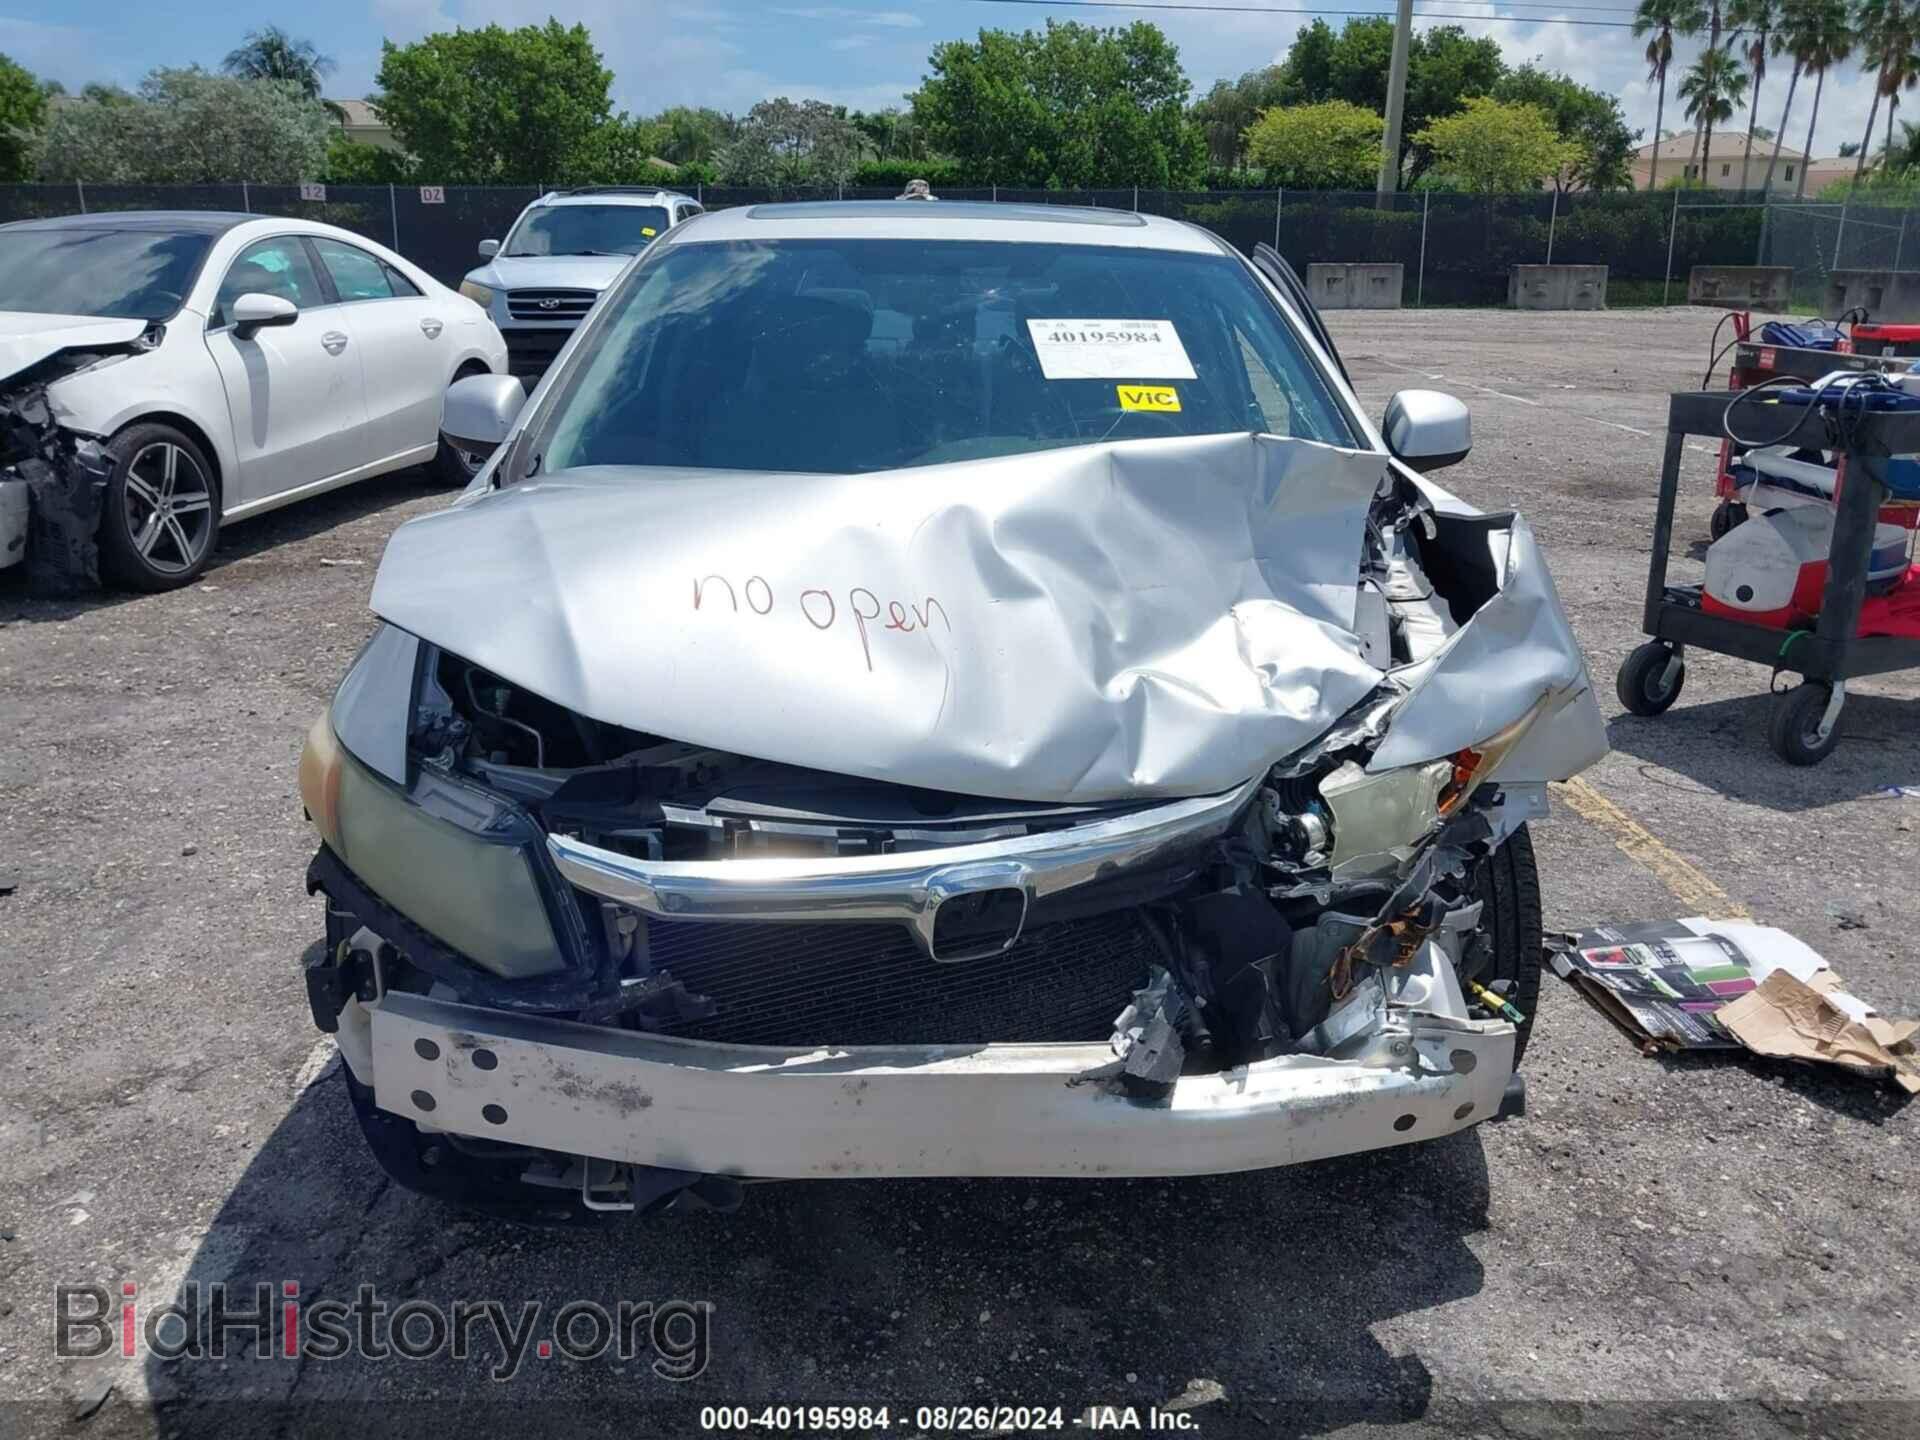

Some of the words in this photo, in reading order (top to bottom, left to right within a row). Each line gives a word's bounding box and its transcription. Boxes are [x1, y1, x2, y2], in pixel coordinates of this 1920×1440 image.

[1047, 331, 1162, 343] 40195984
[693, 574, 774, 615] no
[799, 587, 951, 672] open
